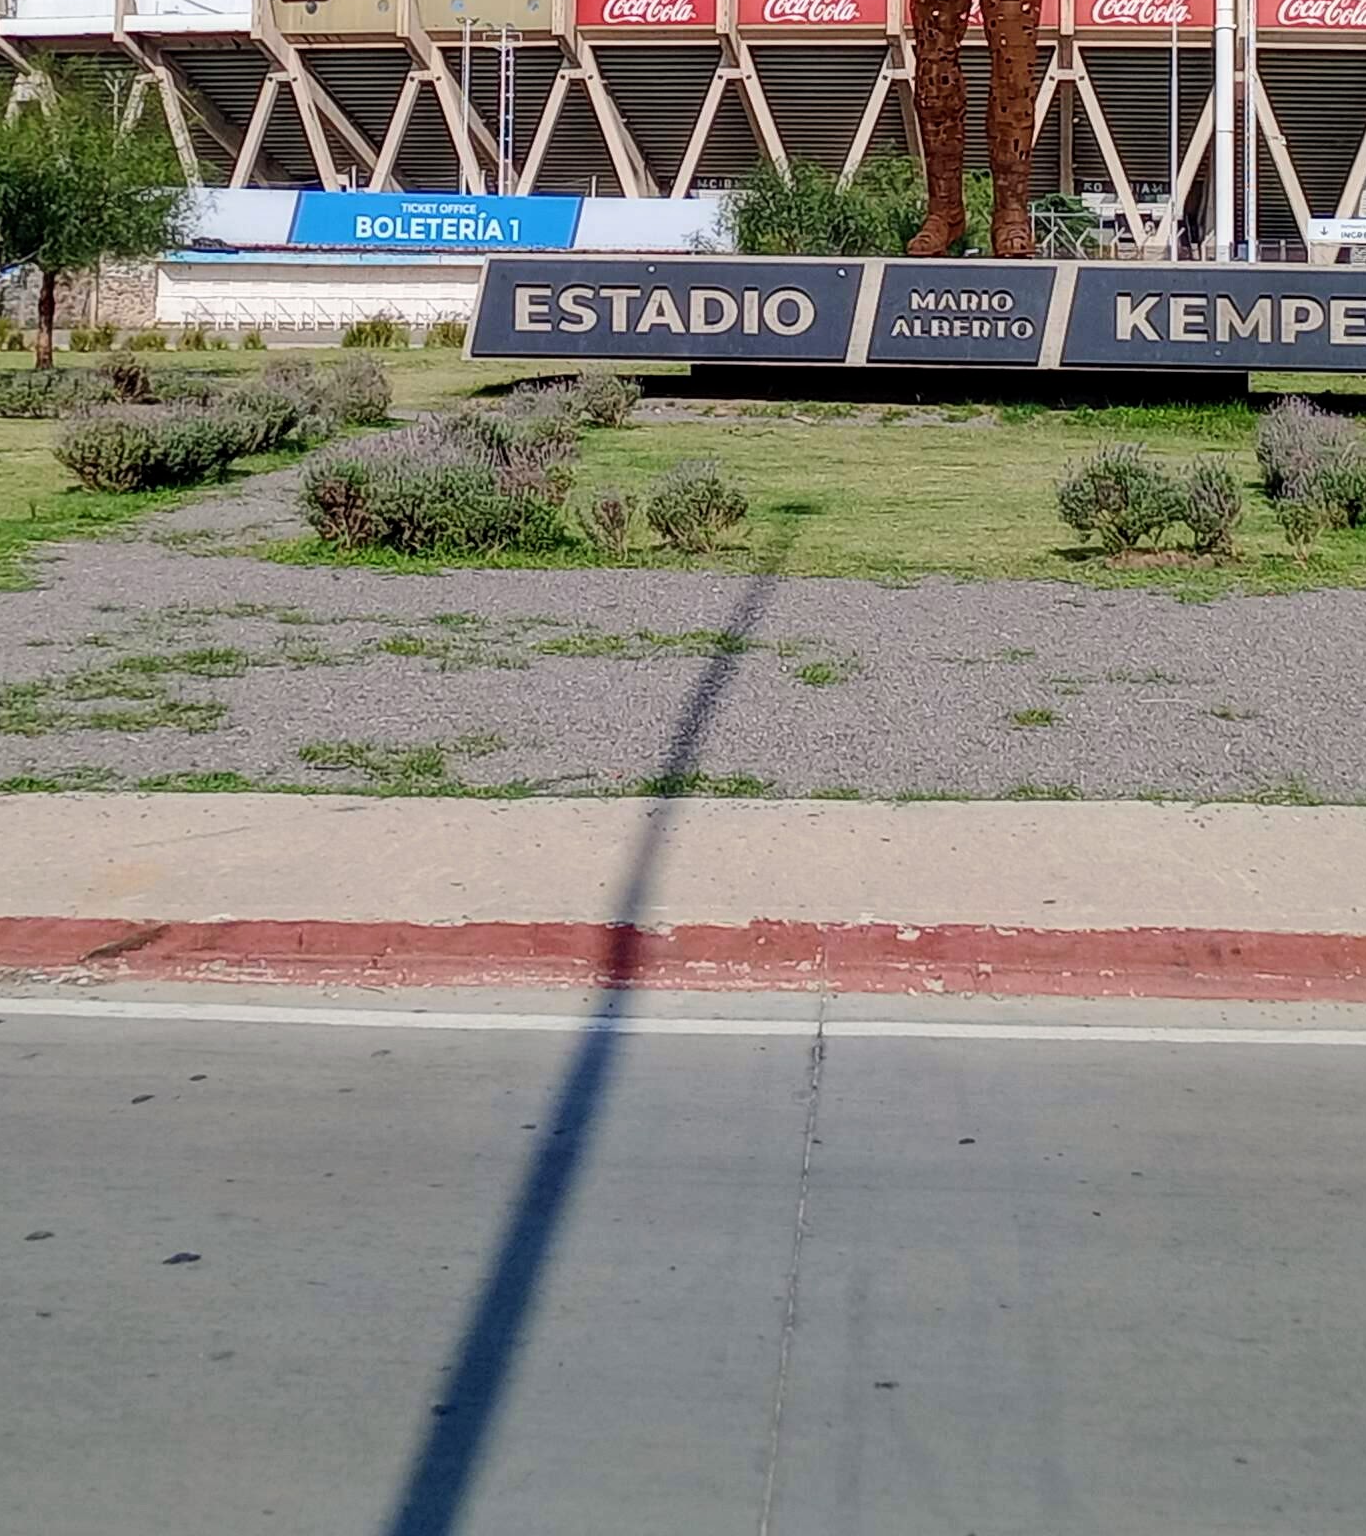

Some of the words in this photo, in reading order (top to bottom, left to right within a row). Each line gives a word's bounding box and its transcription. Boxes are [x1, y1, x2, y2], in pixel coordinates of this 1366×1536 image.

[401, 203, 438, 214] TICKET
[439, 204, 477, 214] OFFICE
[355, 212, 504, 241] BOLETERÍA
[509, 219, 520, 241] 1
[514, 285, 816, 336] ESTADIO
[910, 289, 1014, 312] MARIO
[891, 316, 1034, 339] ALBERTO
